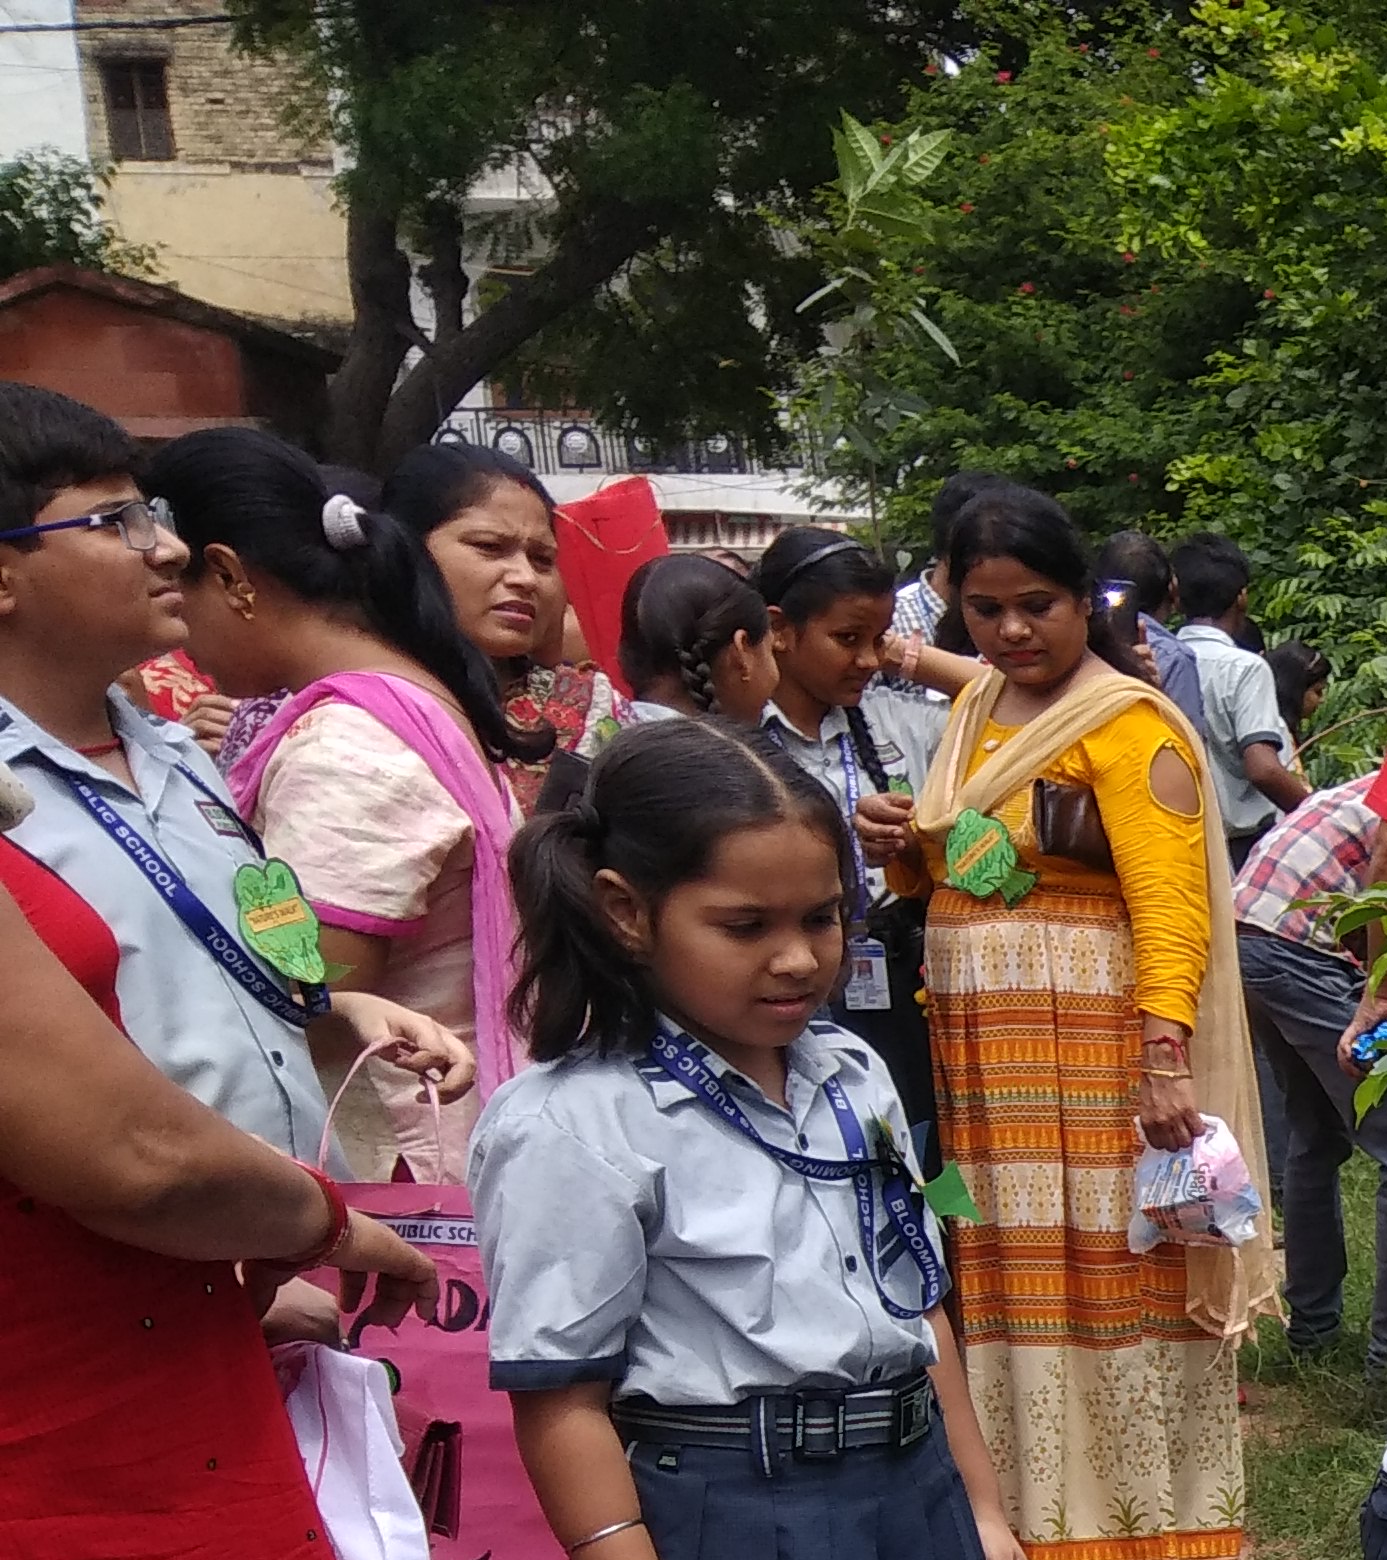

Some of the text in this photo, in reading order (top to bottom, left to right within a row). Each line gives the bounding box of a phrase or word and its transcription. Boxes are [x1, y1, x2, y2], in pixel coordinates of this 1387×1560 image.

[79, 785, 177, 898] BLIC SCHOOL
[207, 927, 266, 993] SCHOOL
[677, 1056, 736, 1117] PUBLIC
[891, 1198, 940, 1297] BLOOMING
